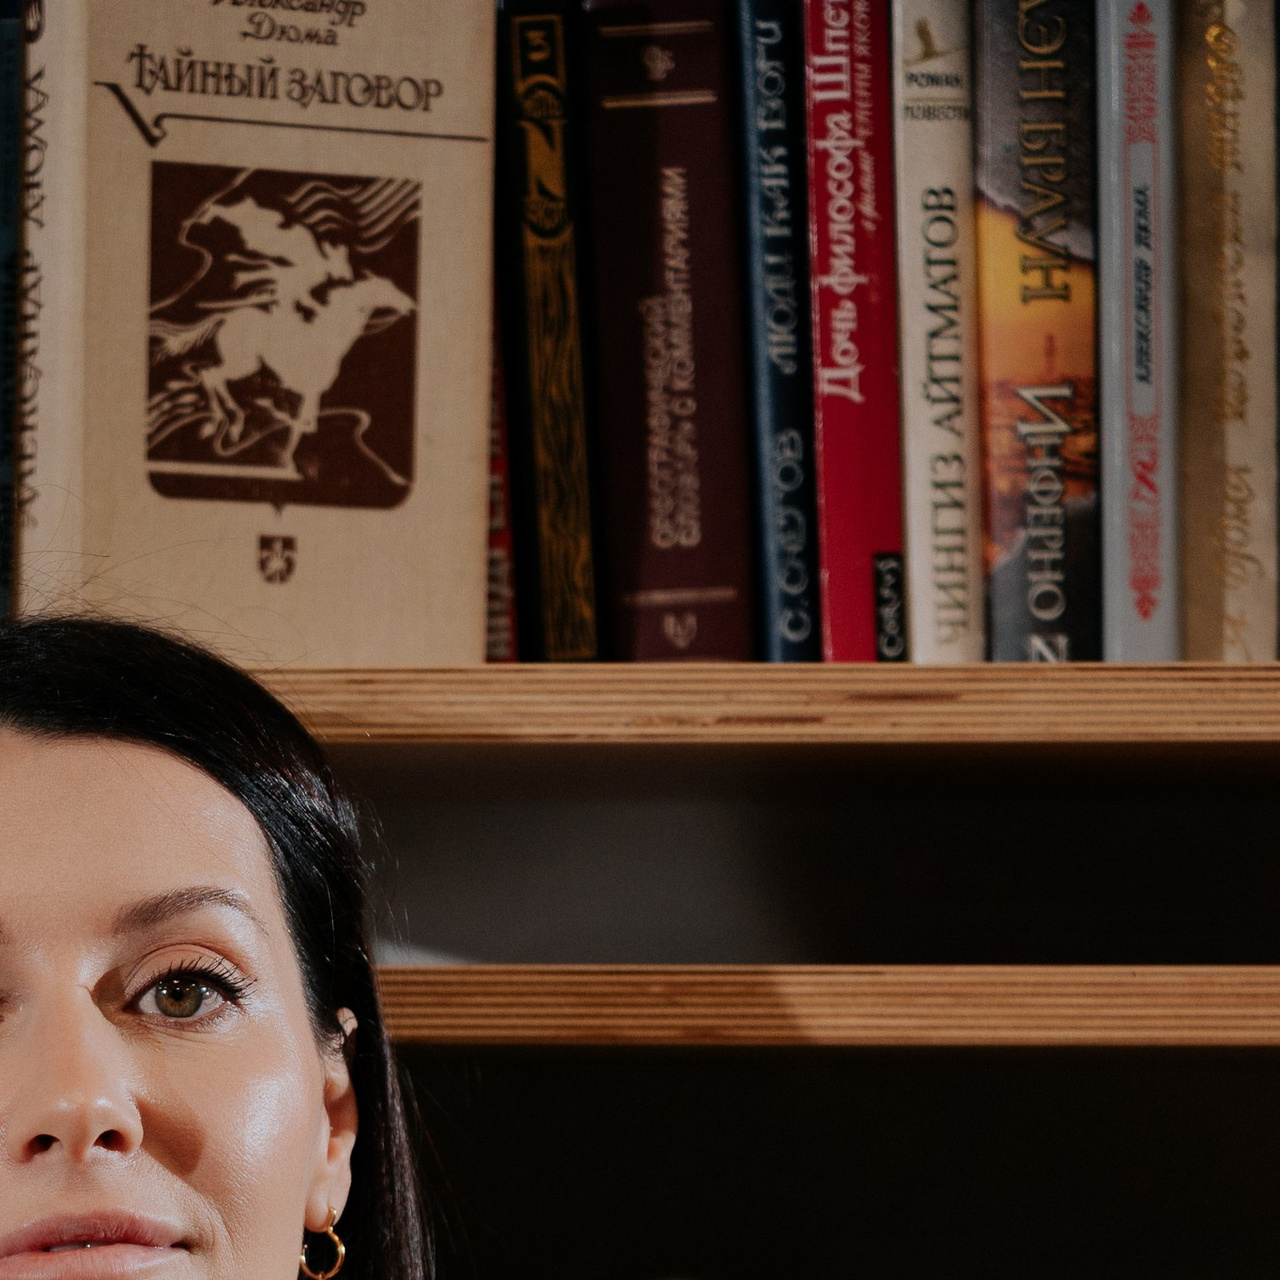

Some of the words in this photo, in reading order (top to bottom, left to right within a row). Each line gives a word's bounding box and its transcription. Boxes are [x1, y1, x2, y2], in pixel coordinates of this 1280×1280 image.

[126, 44, 282, 100] ТАЙНЫЙ
[286, 67, 444, 112] ЗАГОВОР
[240, 11, 339, 46] Дюма
[661, 166, 696, 392] КОММЕНТАРИЯМИ
[815, 109, 870, 297] философа
[1017, 122, 1072, 304] БРАУН
[821, 299, 867, 404] Дочь
[921, 185, 963, 434] АЙТМАТОВ
[928, 452, 968, 647] ЧИНГИЗ
[1015, 380, 1076, 621] ИНФЕРНО
